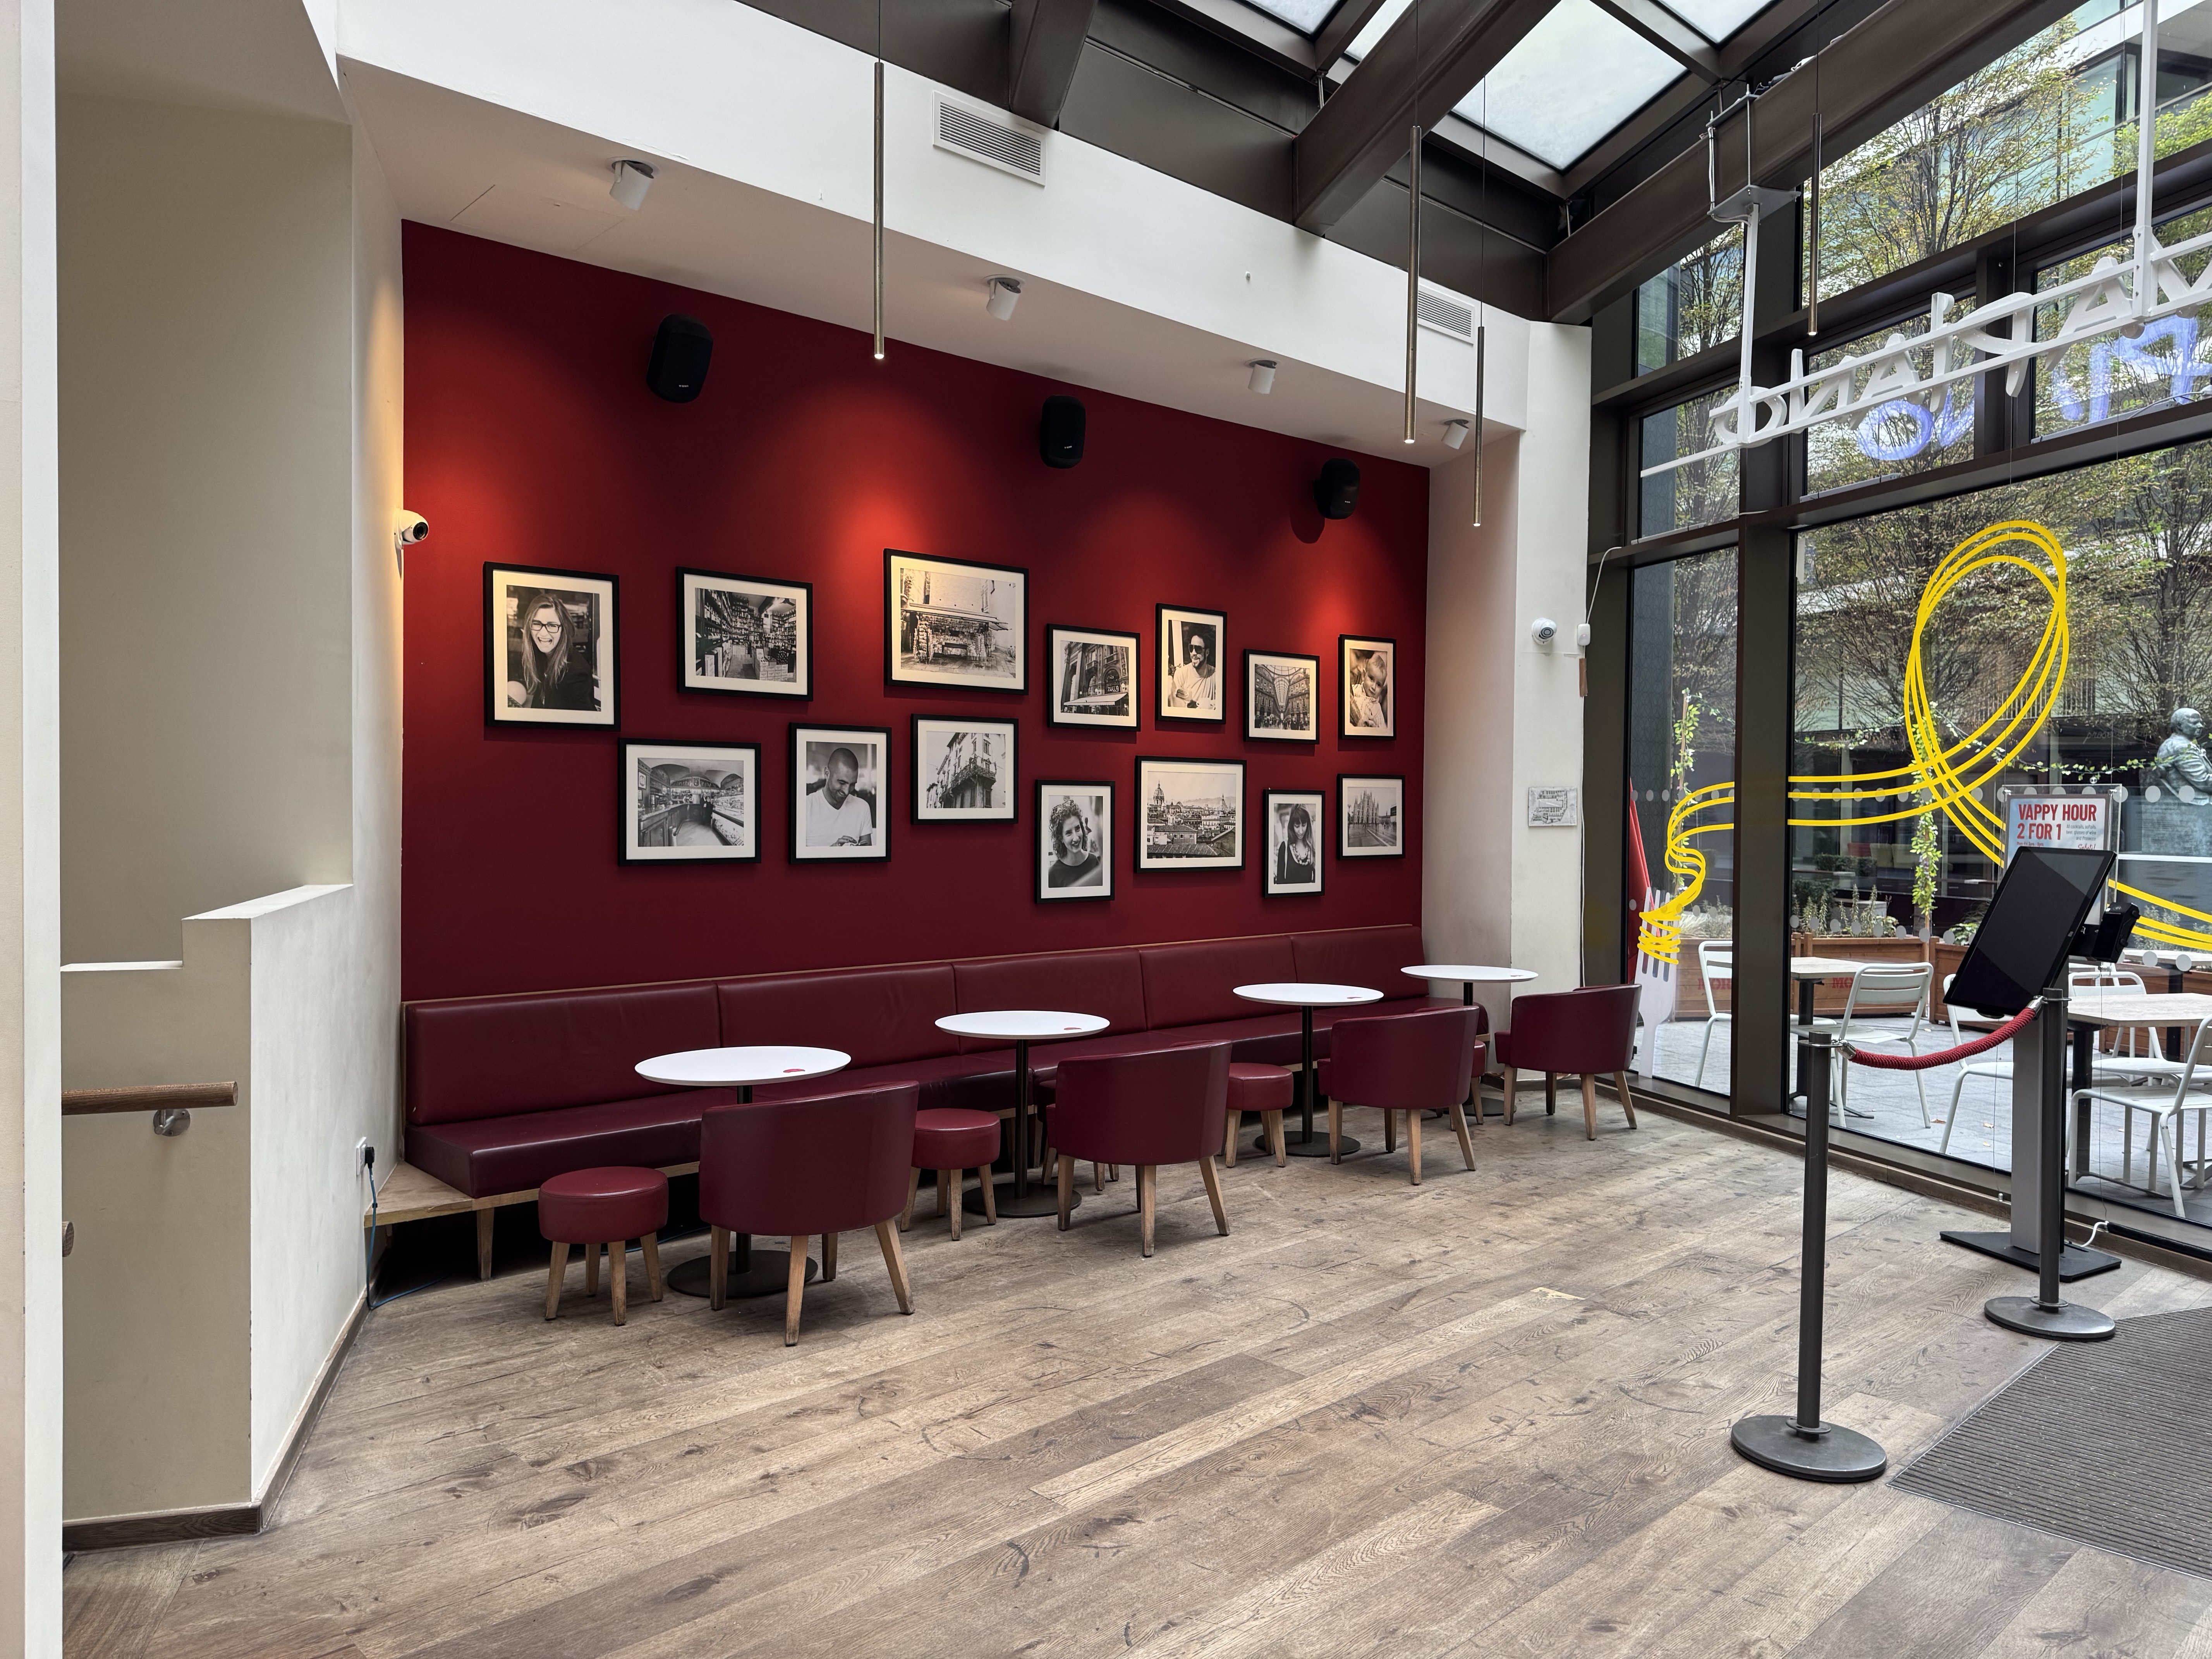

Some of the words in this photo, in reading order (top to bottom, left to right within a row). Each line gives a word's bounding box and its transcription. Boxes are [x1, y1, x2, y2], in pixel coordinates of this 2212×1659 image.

[2018, 804, 2058, 821] VAPPY
[2062, 804, 2097, 821] HOUR
[2017, 823, 2025, 839] 2
[2028, 823, 2052, 840] FOR
[2056, 824, 2061, 840] 1
